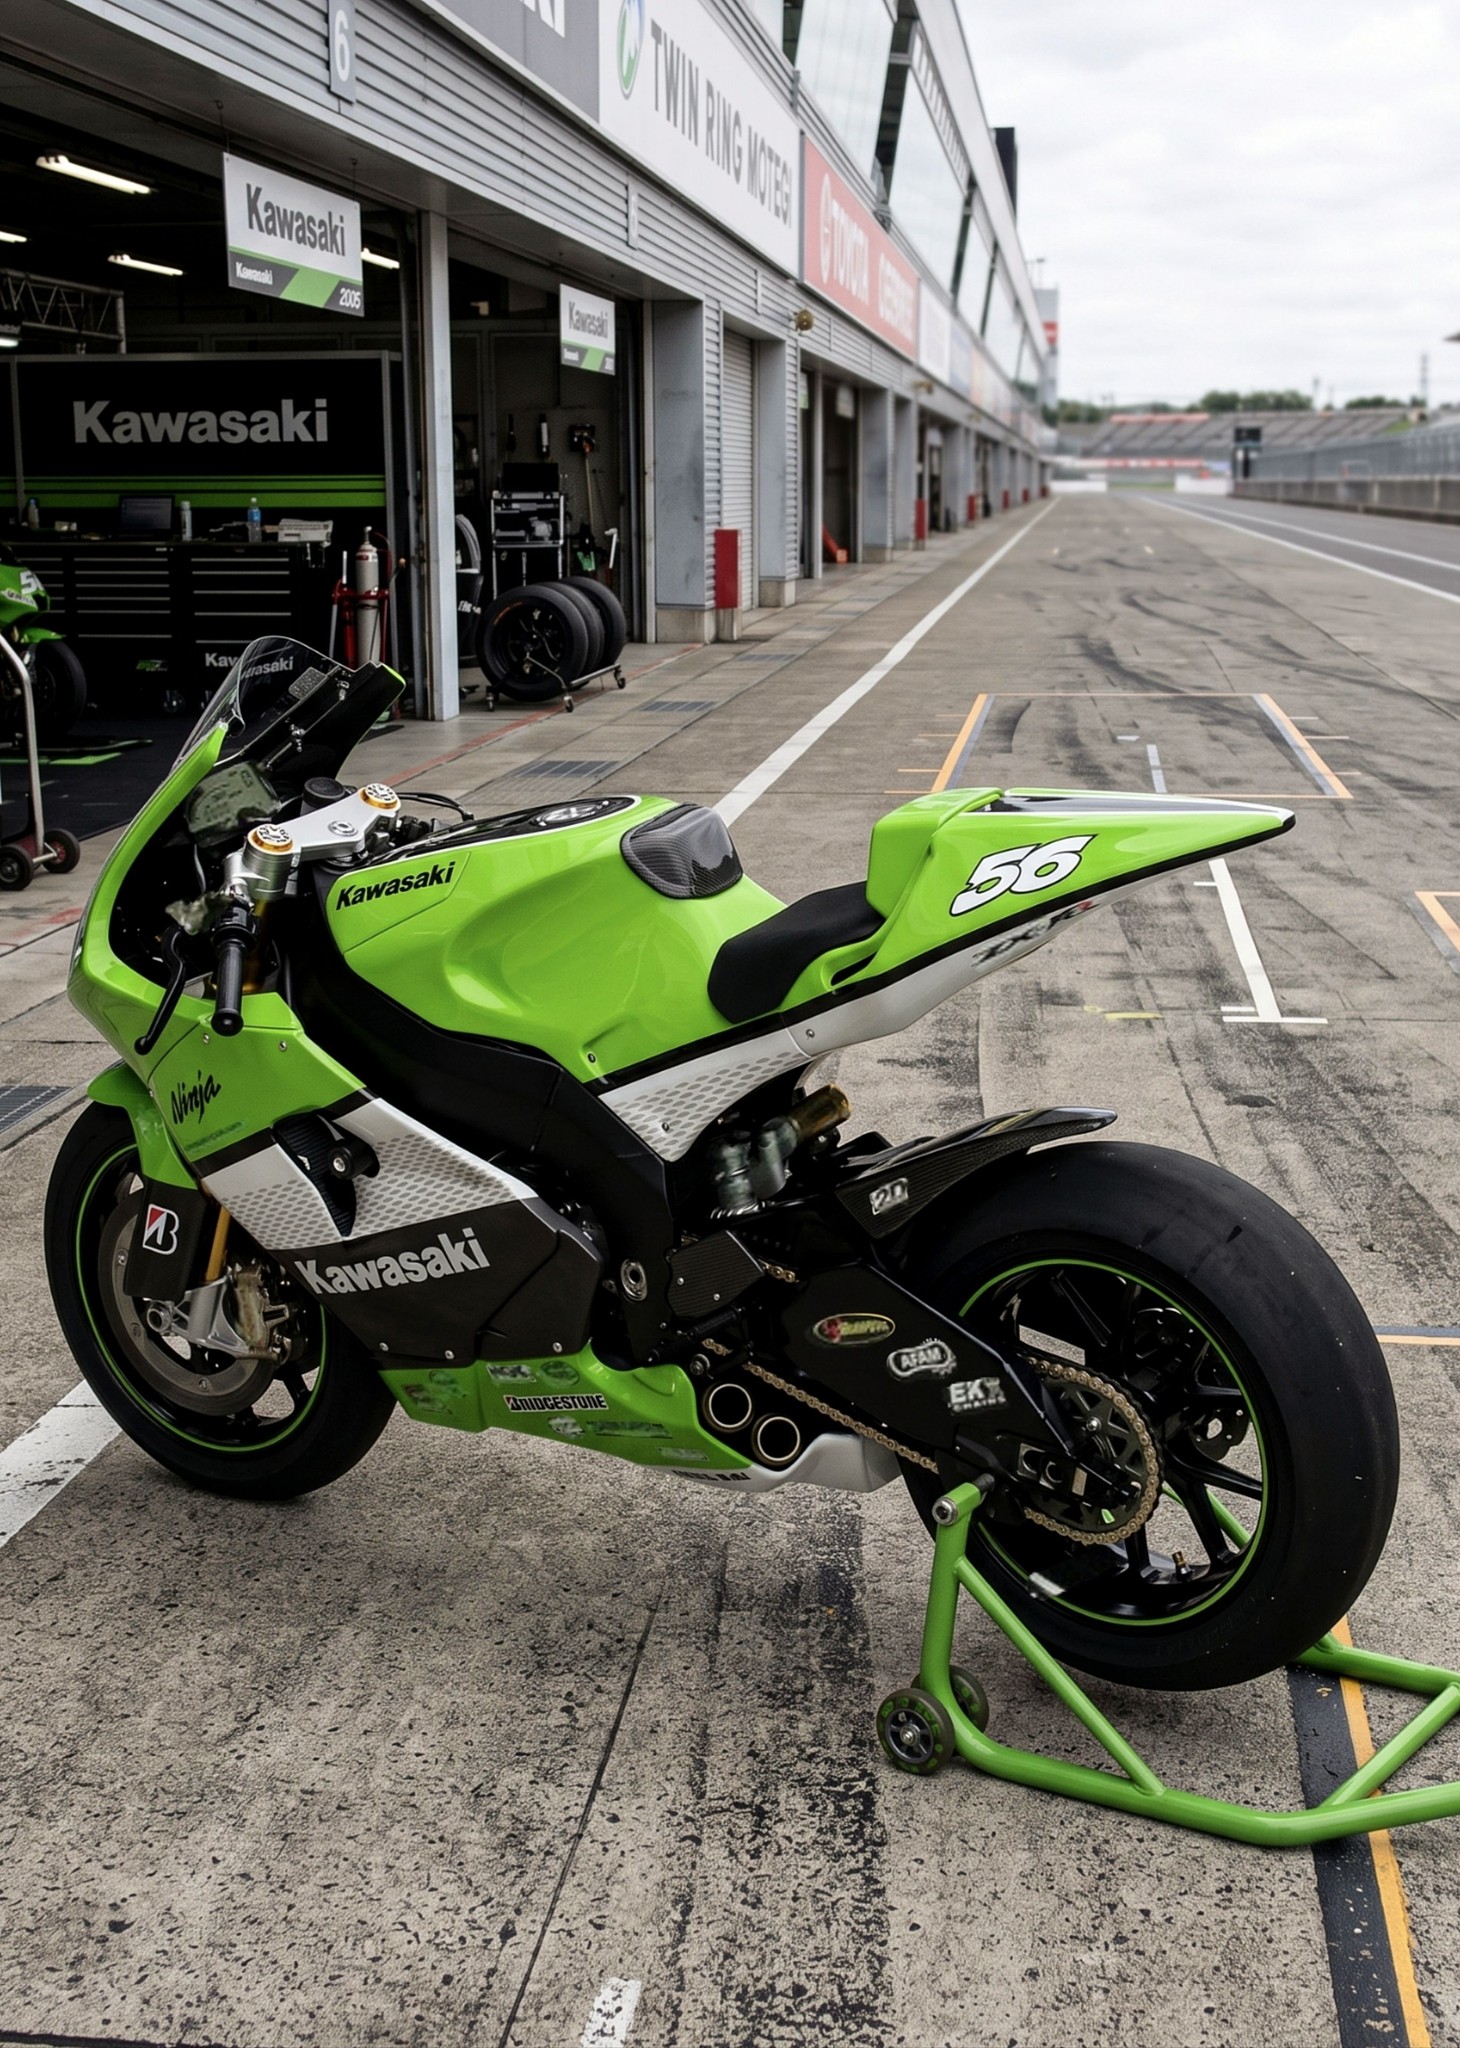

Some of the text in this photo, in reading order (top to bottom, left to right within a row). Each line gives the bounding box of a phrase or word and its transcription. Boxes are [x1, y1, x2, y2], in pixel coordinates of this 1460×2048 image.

[333, 9, 351, 82] 6
[651, 18, 793, 229] TWIN RING MOTEGI
[246, 182, 345, 257] Kawasaki
[339, 287, 361, 310] 2005
[568, 301, 608, 339] Kawasaki
[73, 398, 328, 444] Kawasaki
[335, 861, 456, 911] Kawasaki
[949, 834, 1099, 917] 56
[171, 1069, 222, 1124] Ninja
[294, 1227, 490, 1295] Kawasaki
[901, 1346, 942, 1369] AFAM
[504, 1394, 607, 1411] BRIDGESTONE
